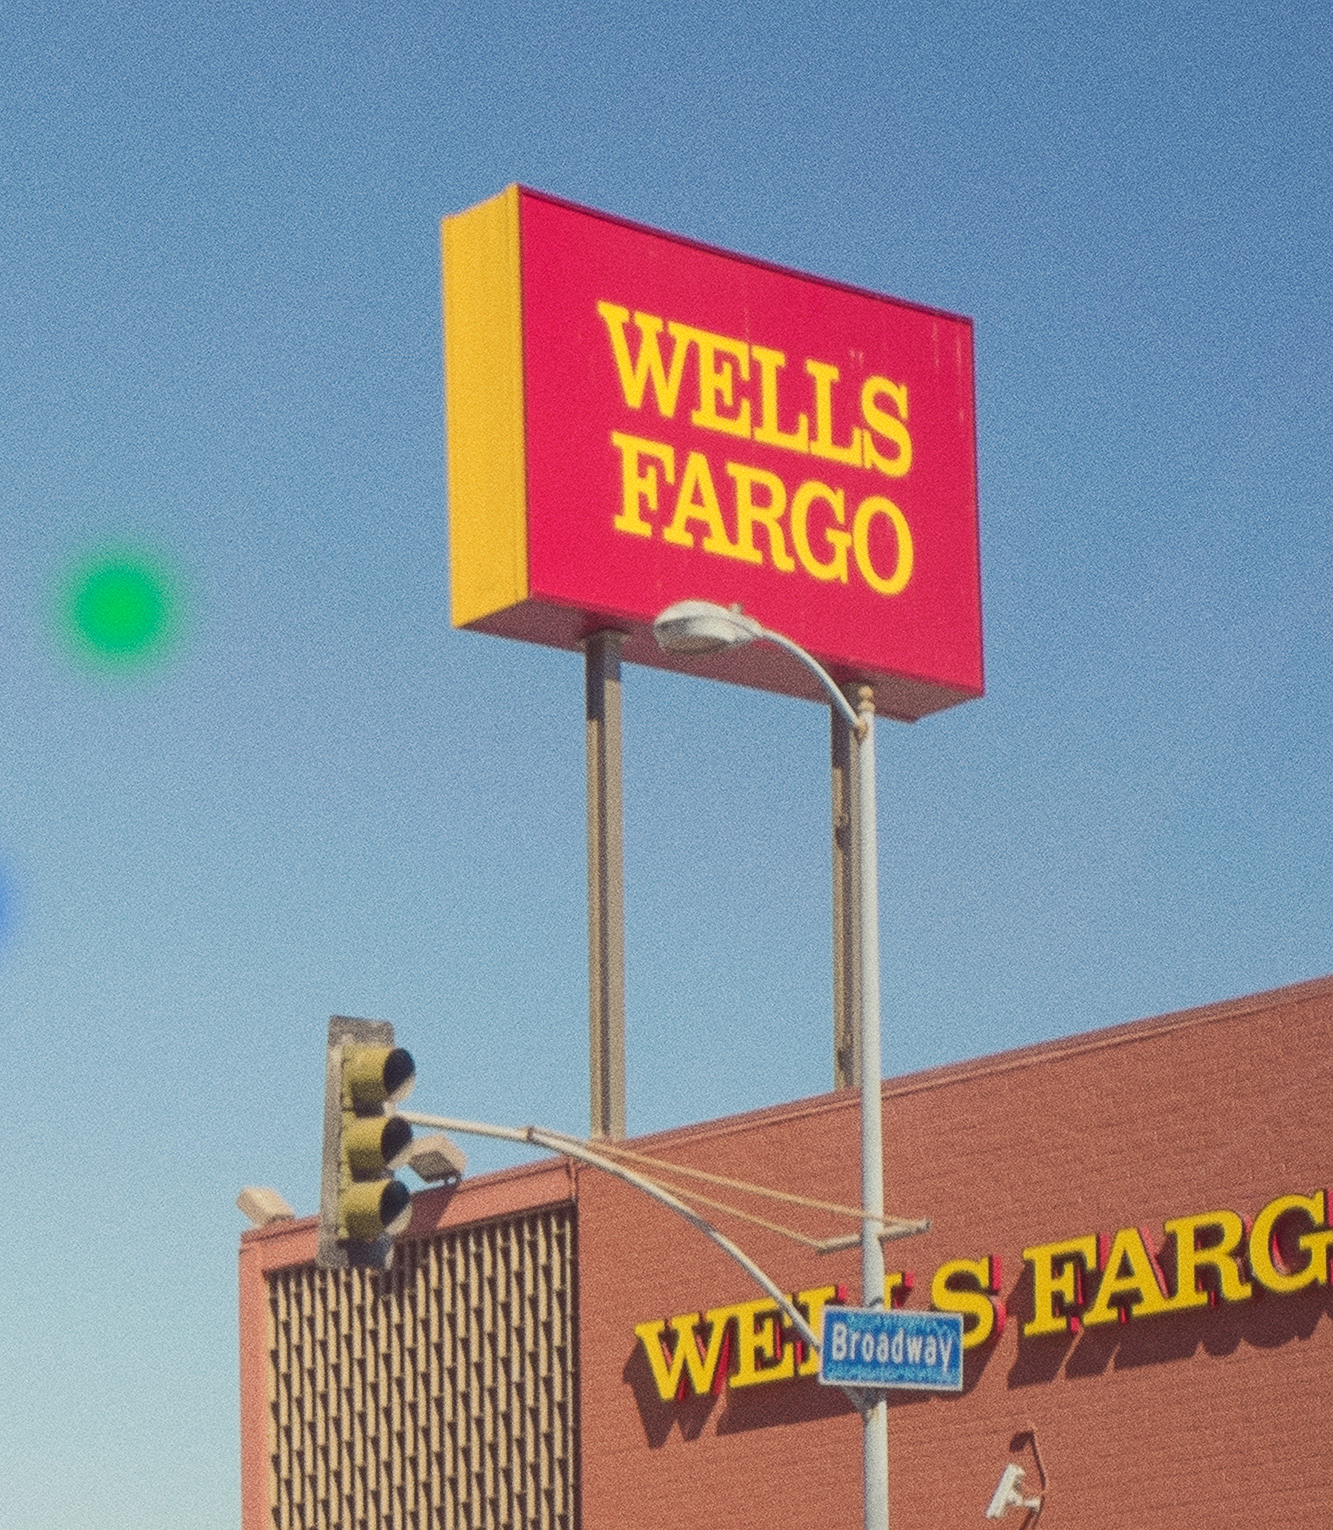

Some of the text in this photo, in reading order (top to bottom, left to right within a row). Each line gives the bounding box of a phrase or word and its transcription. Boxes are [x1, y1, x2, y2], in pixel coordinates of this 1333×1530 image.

[596, 300, 913, 477] WELLS
[611, 430, 915, 596] FARGO
[634, 1258, 997, 1401] WELS
[832, 1321, 953, 1374] Broadway
